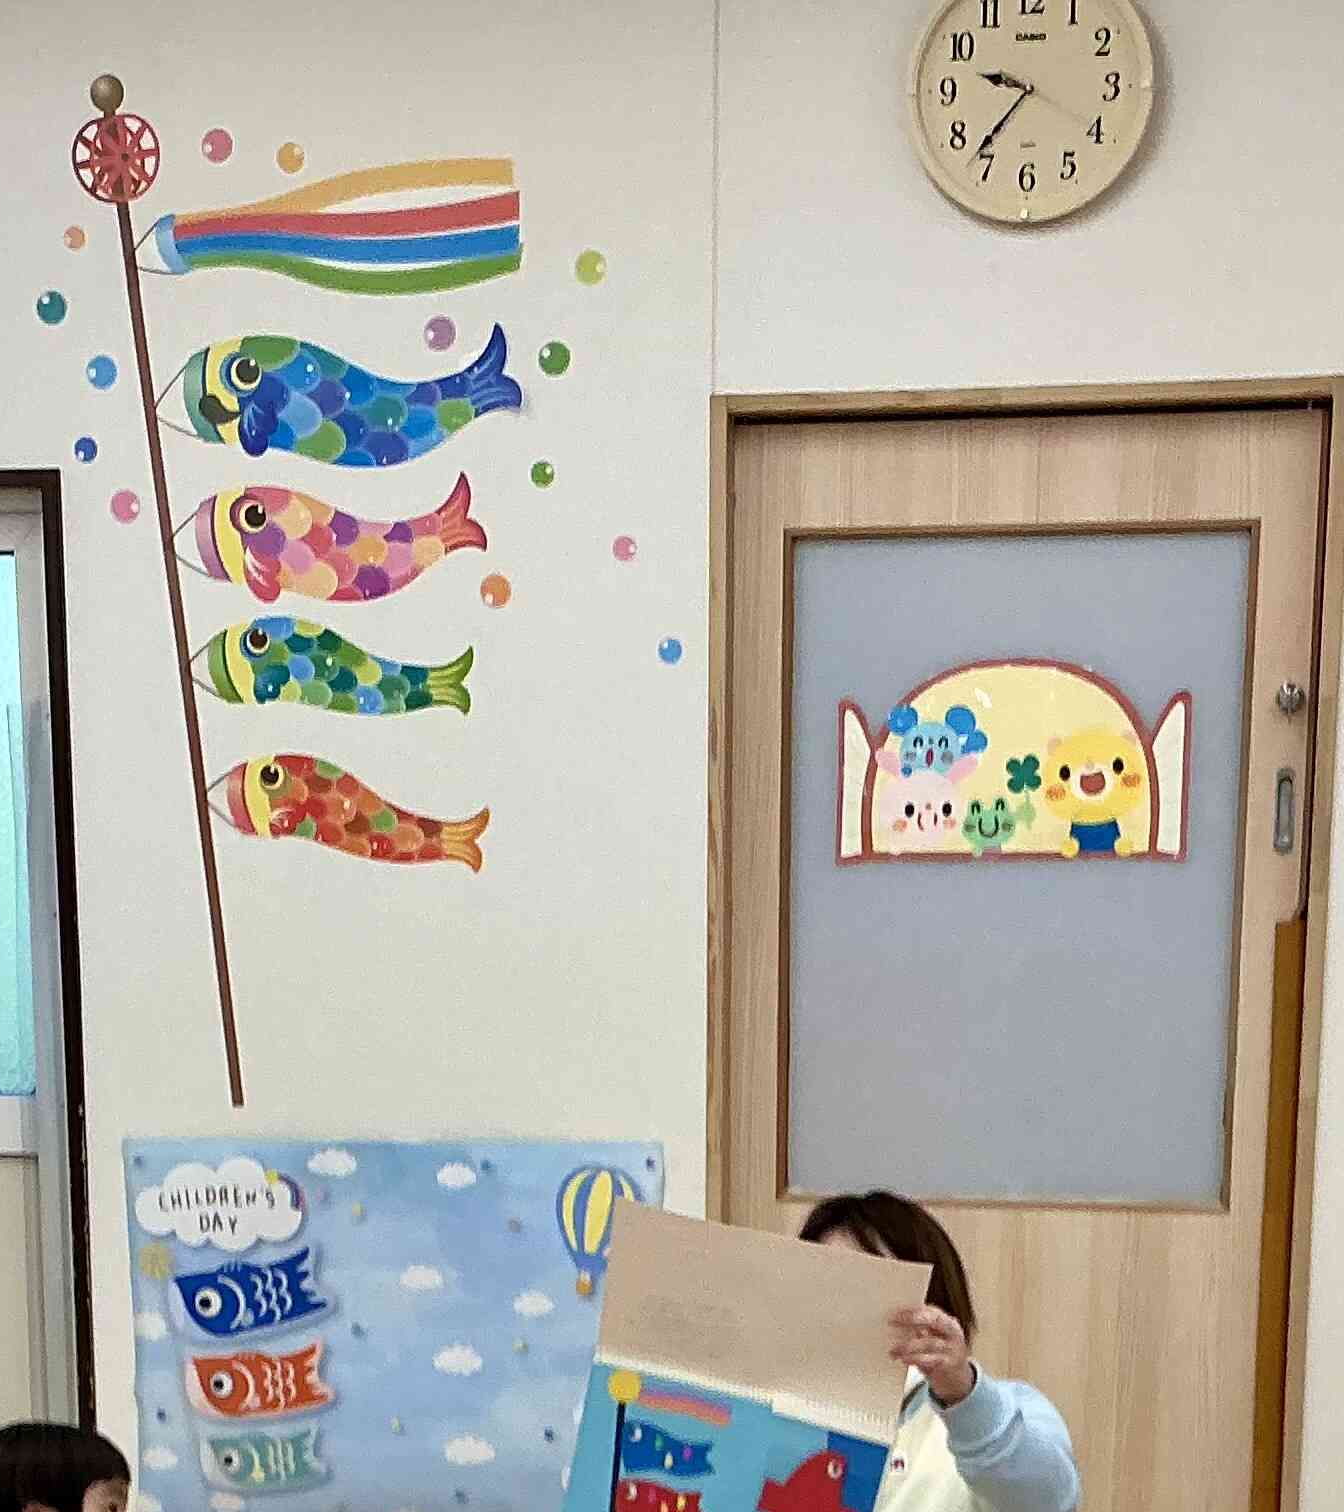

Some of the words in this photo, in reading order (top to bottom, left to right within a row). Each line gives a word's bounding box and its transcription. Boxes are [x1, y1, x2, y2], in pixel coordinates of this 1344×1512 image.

[950, 31, 974, 62] 10
[1094, 27, 1111, 57] 2
[939, 76, 957, 106] 9
[1102, 71, 1121, 102] 3
[949, 120, 967, 150] 8
[1086, 115, 1105, 145] 4
[979, 152, 995, 182] 7
[1018, 163, 1036, 192] 6
[1060, 150, 1077, 180] 5
[158, 1183, 276, 1212] CHILDREN'S
[199, 1211, 238, 1235] DAY
